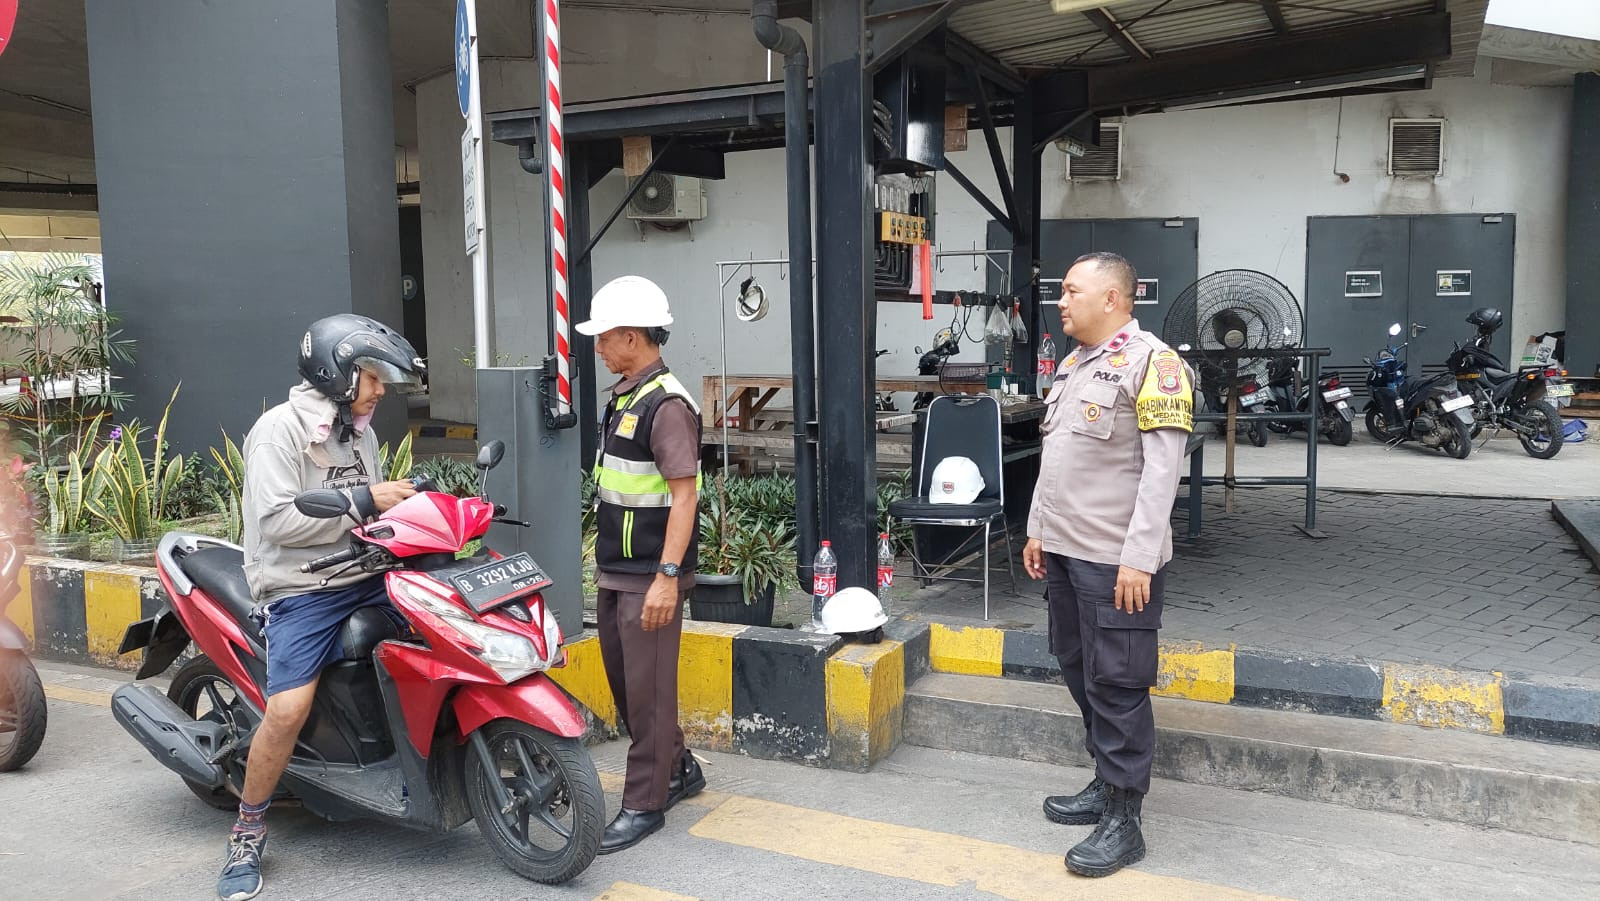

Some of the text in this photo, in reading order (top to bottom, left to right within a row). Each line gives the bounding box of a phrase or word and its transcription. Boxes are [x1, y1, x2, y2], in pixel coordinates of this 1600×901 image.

[403, 279, 413, 295] P
[1093, 370, 1123, 383] POLRI
[460, 580, 473, 592] B
[477, 567, 510, 586] 3292
